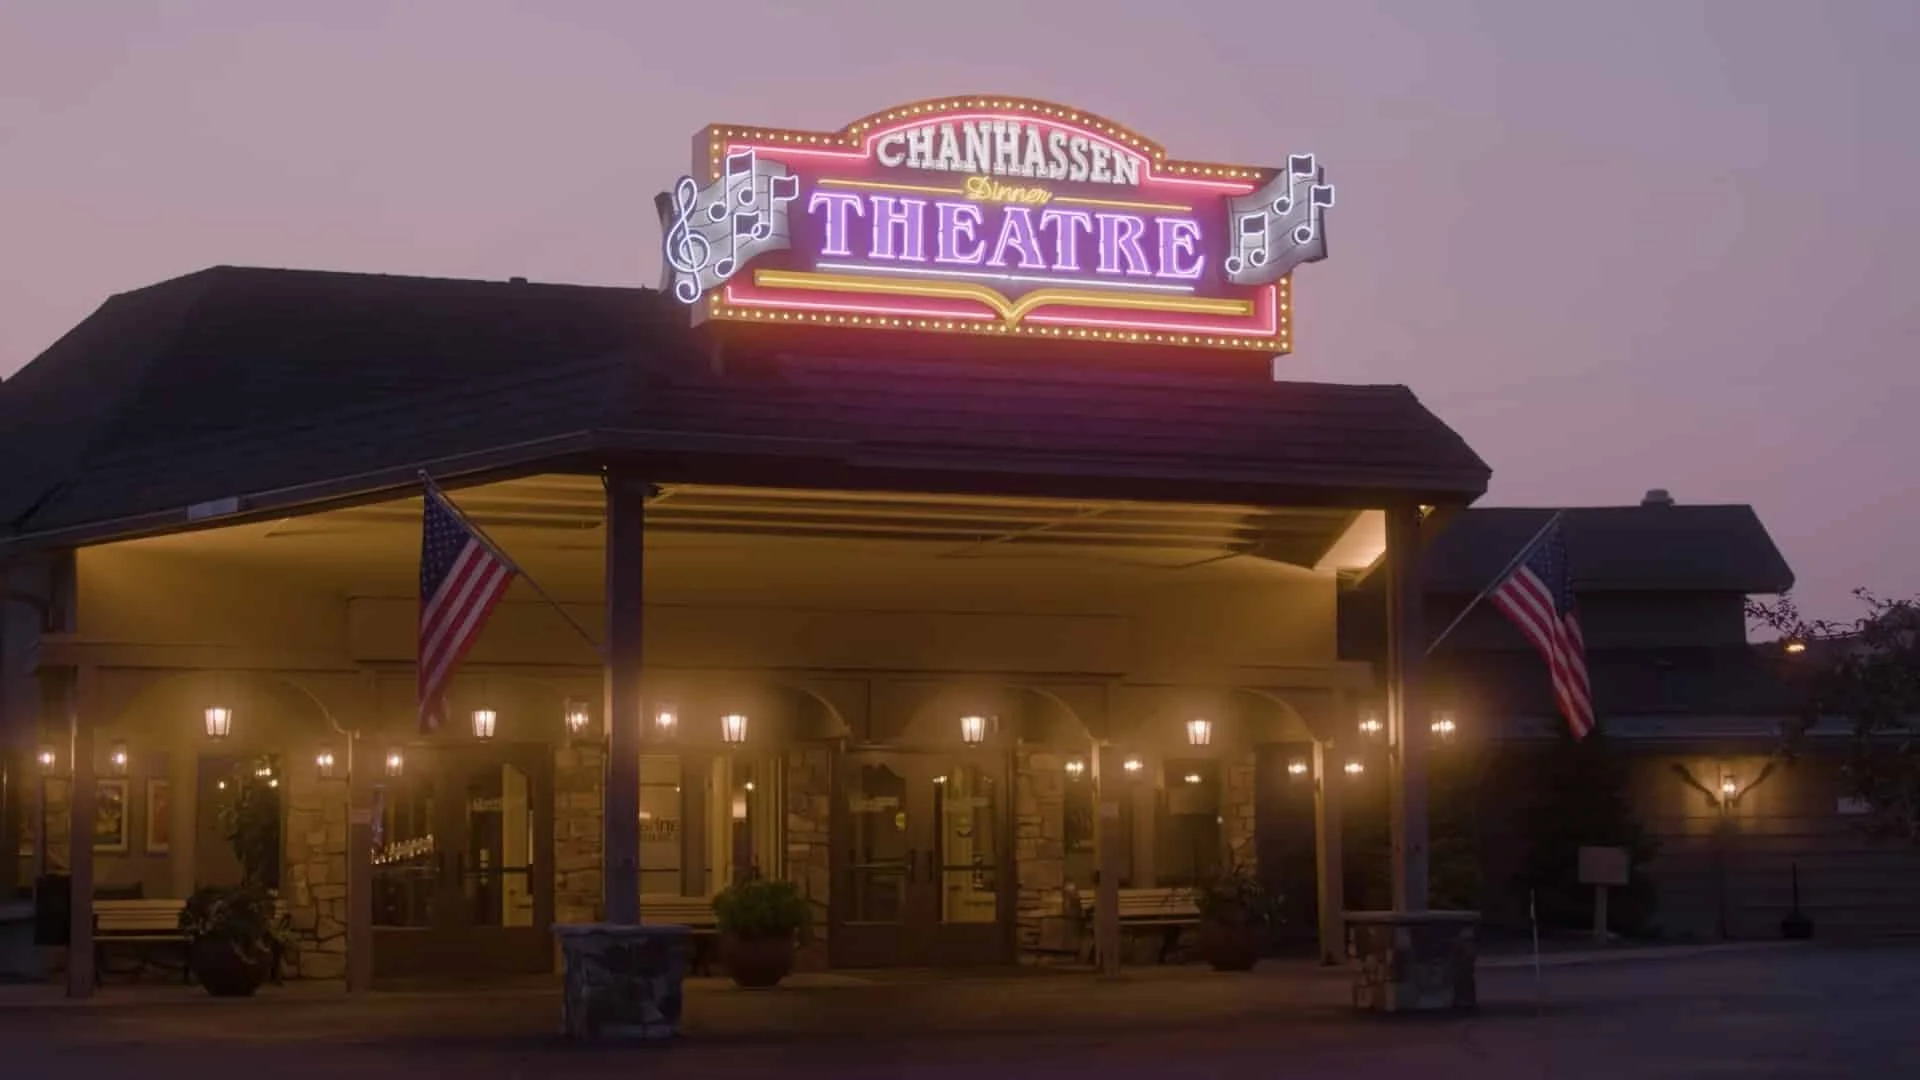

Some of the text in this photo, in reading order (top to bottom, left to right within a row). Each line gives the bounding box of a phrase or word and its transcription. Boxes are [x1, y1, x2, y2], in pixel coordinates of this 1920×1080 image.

[877, 121, 1141, 185] CHANHASSEN
[966, 176, 1053, 204] Dinner
[808, 192, 1205, 279] THEATRE
